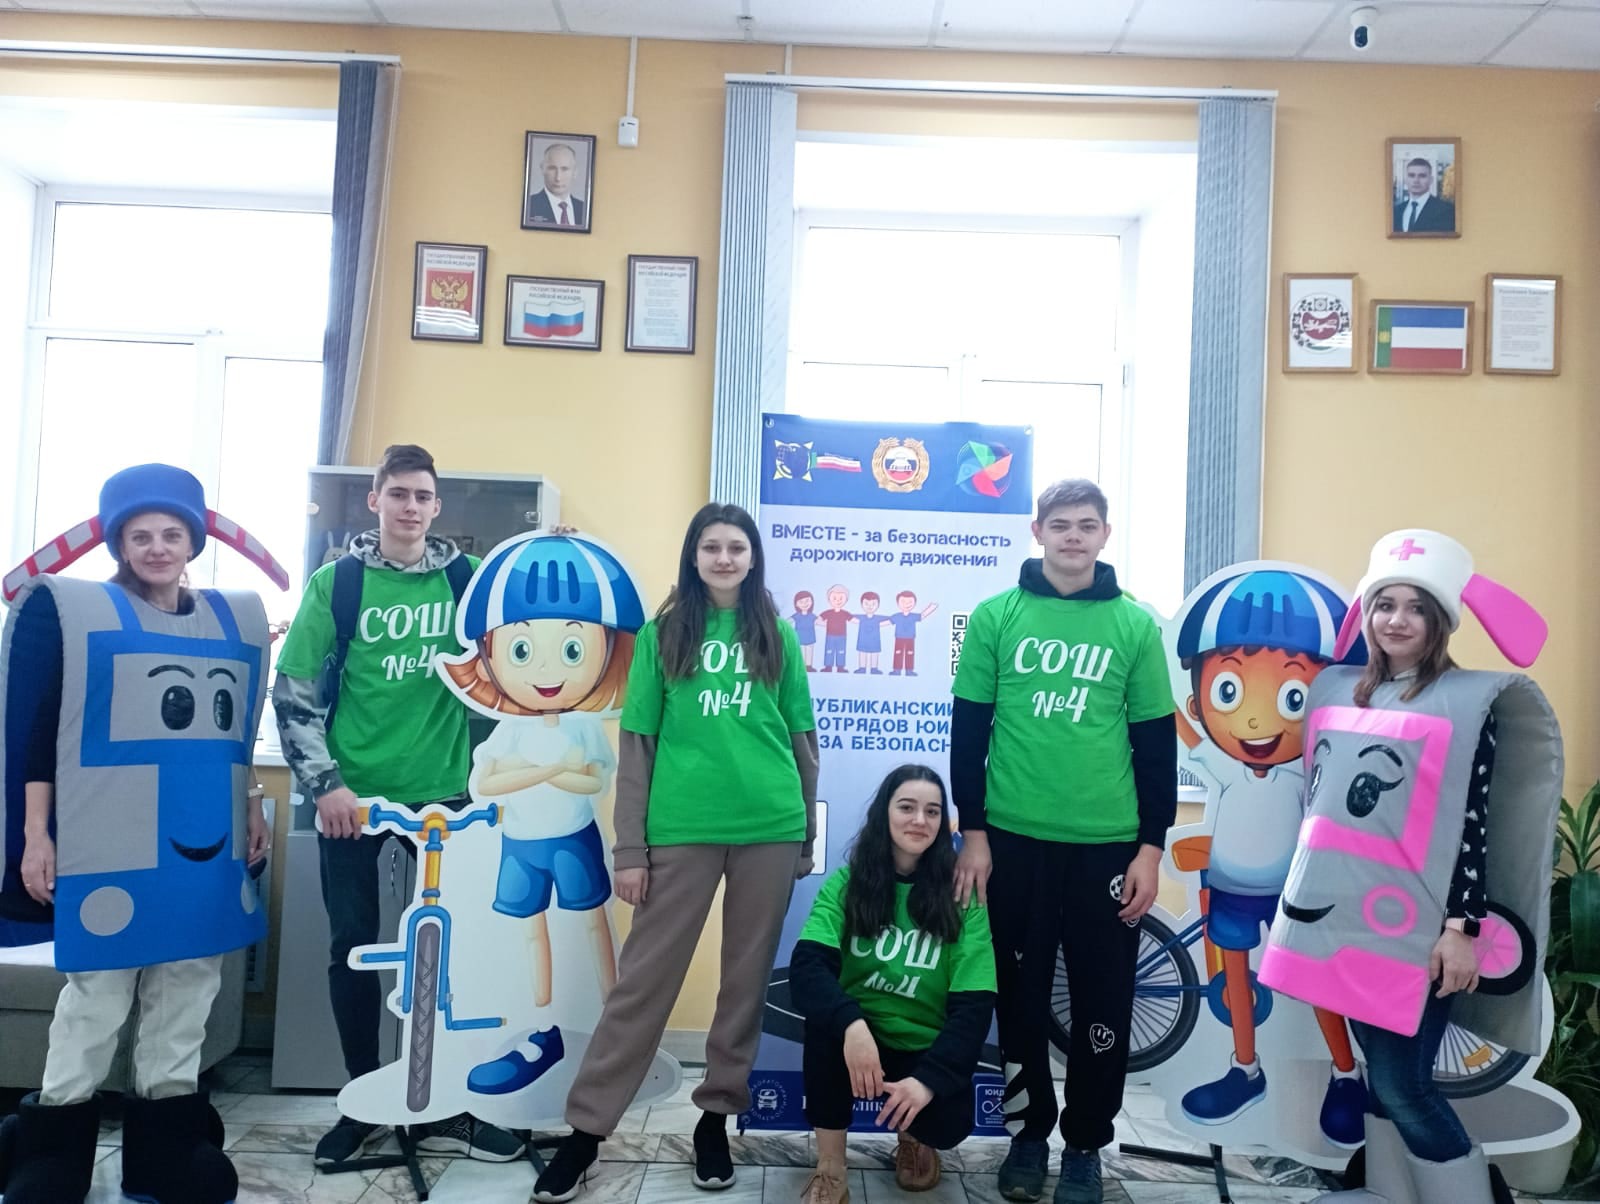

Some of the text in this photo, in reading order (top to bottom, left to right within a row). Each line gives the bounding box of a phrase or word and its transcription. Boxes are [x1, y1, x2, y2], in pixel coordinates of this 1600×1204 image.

[772, 523, 846, 541] ВМЕСТЕ
[865, 530, 883, 543] за
[888, 528, 1012, 548] безопасность
[790, 547, 998, 567] дорожного движения
[360, 601, 453, 643] СОШ
[381, 644, 438, 681] №4
[1014, 637, 1114, 682] СОШ
[698, 681, 753, 717] №4
[811, 697, 953, 717] УБЛИКАНСКИ
[1032, 686, 1089, 723] №4
[818, 716, 950, 735] ОТРЯДОВ ЮИ
[819, 735, 951, 753] ЗА БЕЗОПАСН
[850, 924, 943, 970] СОШ
